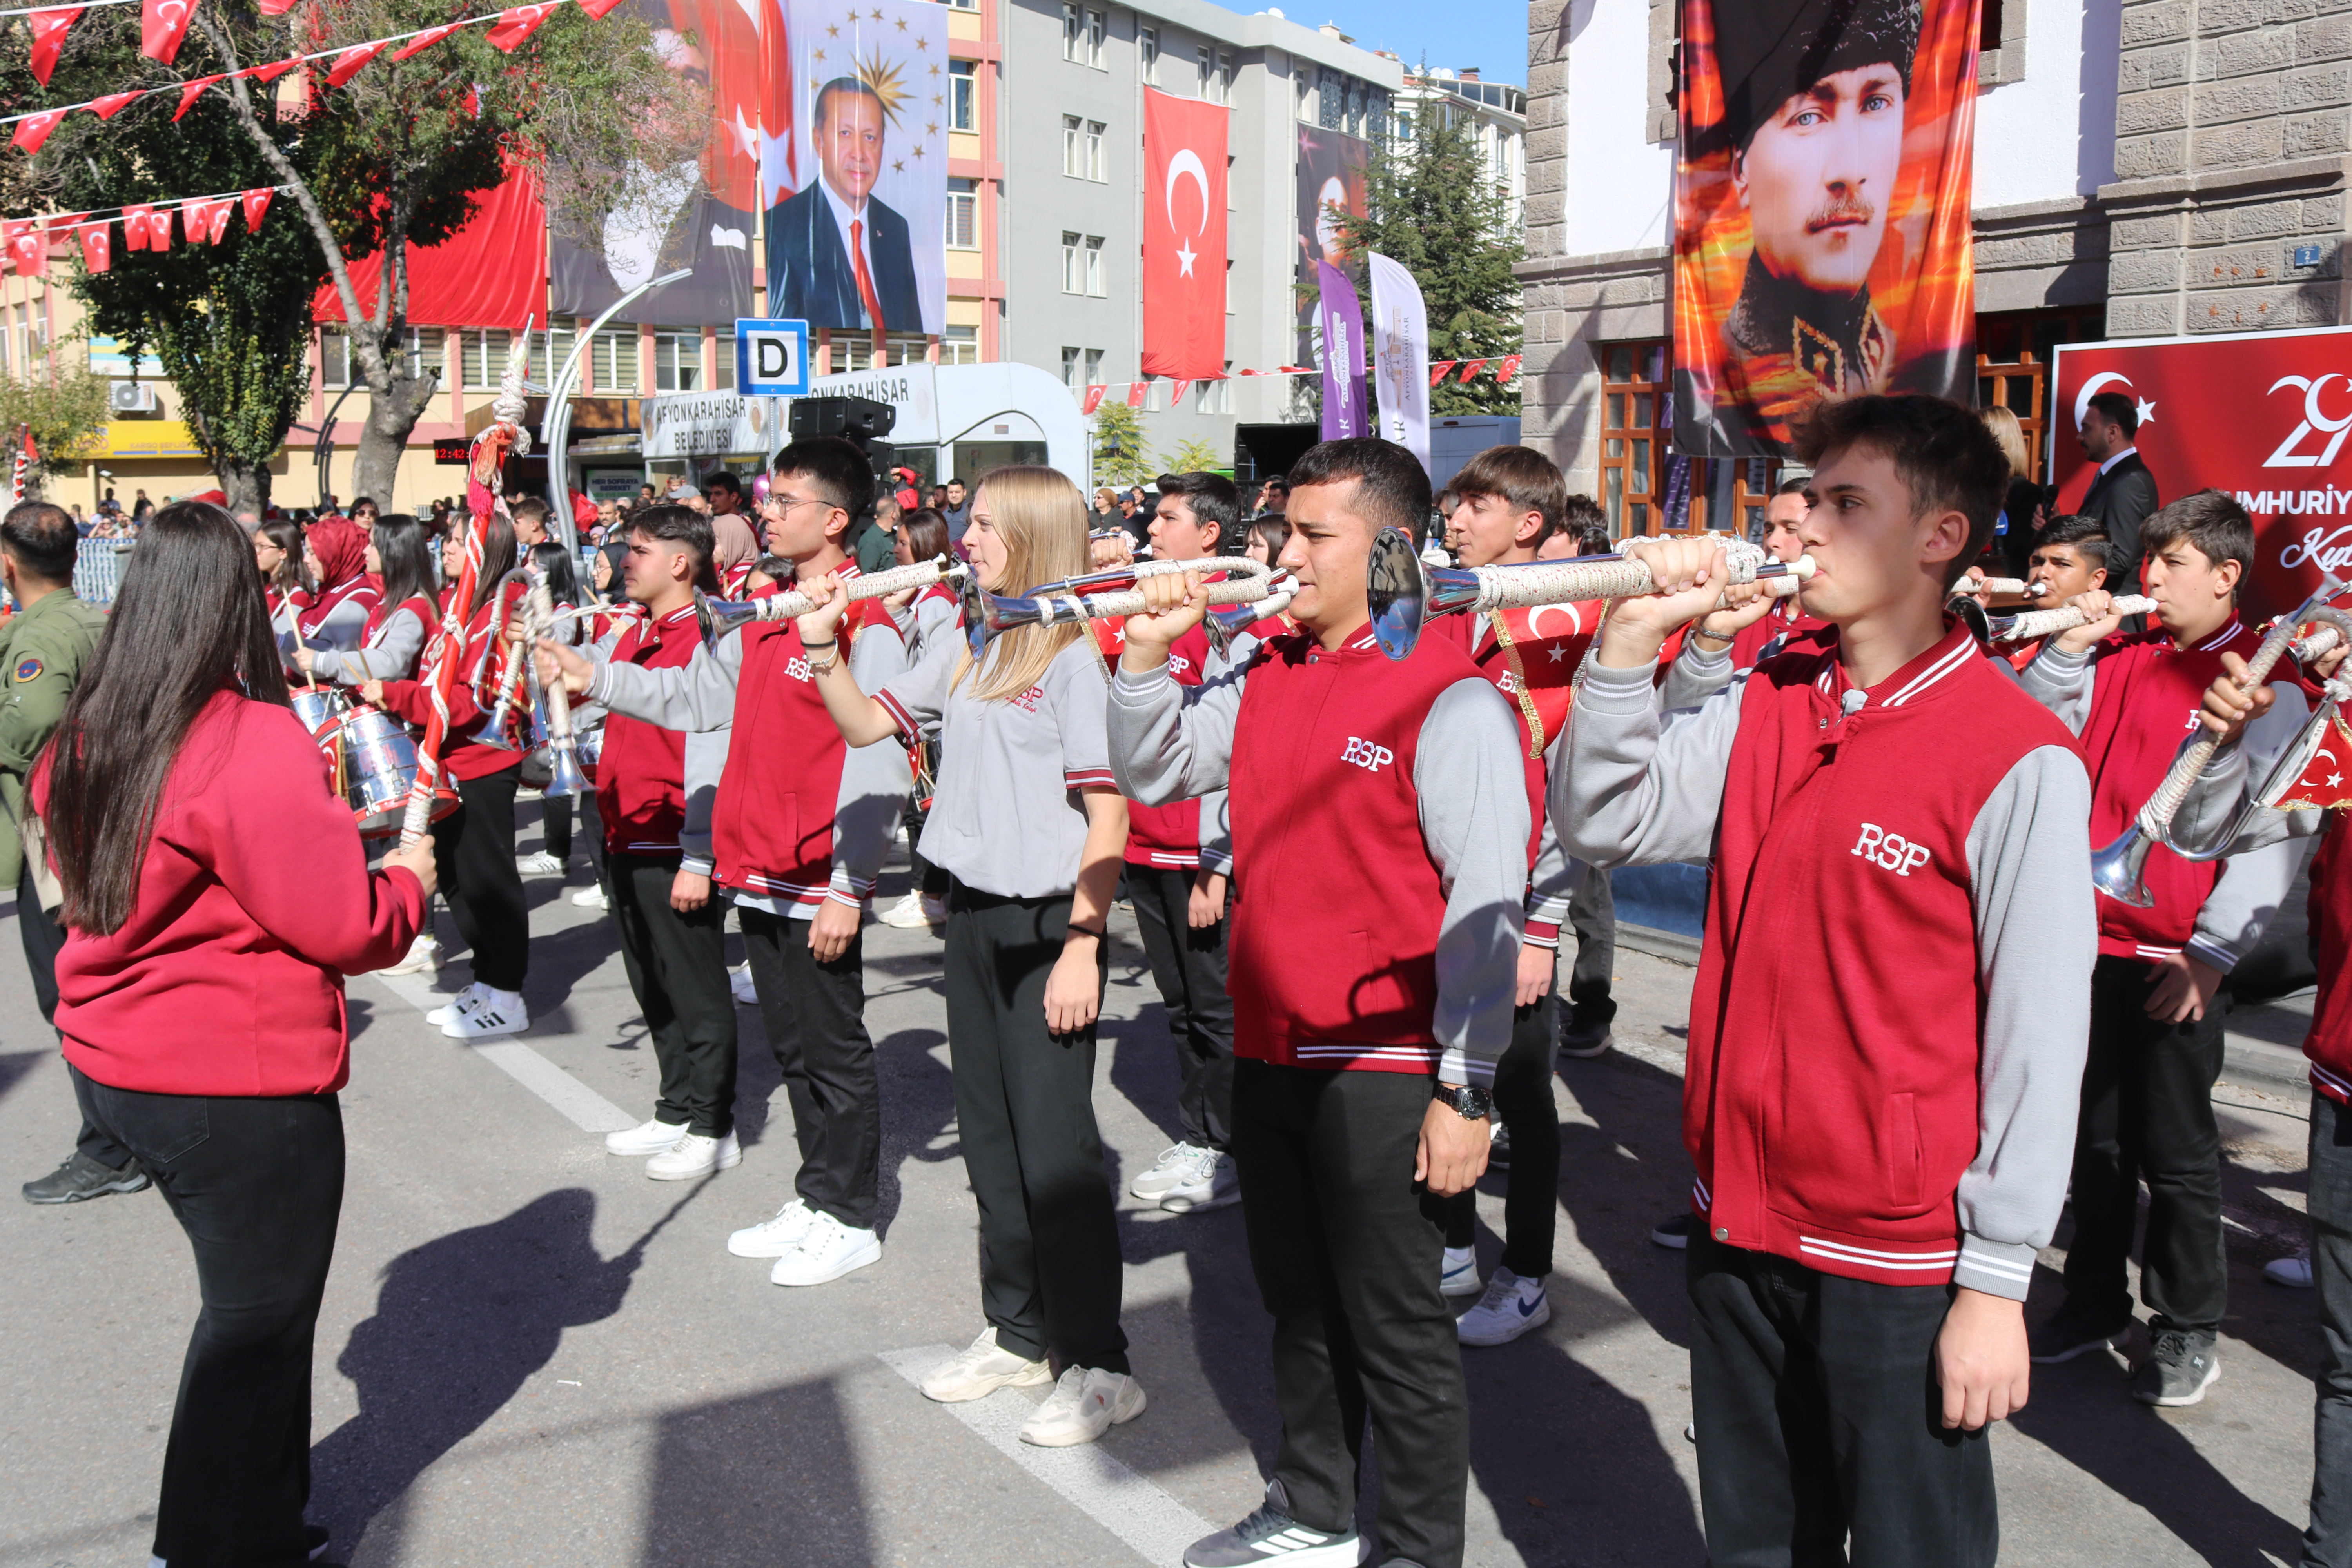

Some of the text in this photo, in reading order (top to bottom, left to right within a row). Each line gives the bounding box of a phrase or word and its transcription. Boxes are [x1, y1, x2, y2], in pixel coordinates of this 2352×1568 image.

[2305, 251, 2310, 260] 2
[758, 338, 788, 377] D
[1402, 316, 1410, 401] AFYONKARAHİSAR
[811, 374, 909, 403] ONKARAHİSAR
[657, 394, 746, 424] AFYONKARAHİSAR
[675, 424, 732, 450] BELEDİYESİ
[1168, 653, 1190, 674] SP
[1019, 686, 1044, 703] SP
[1340, 736, 1394, 772] RSP
[1850, 822, 1930, 877] RSP
